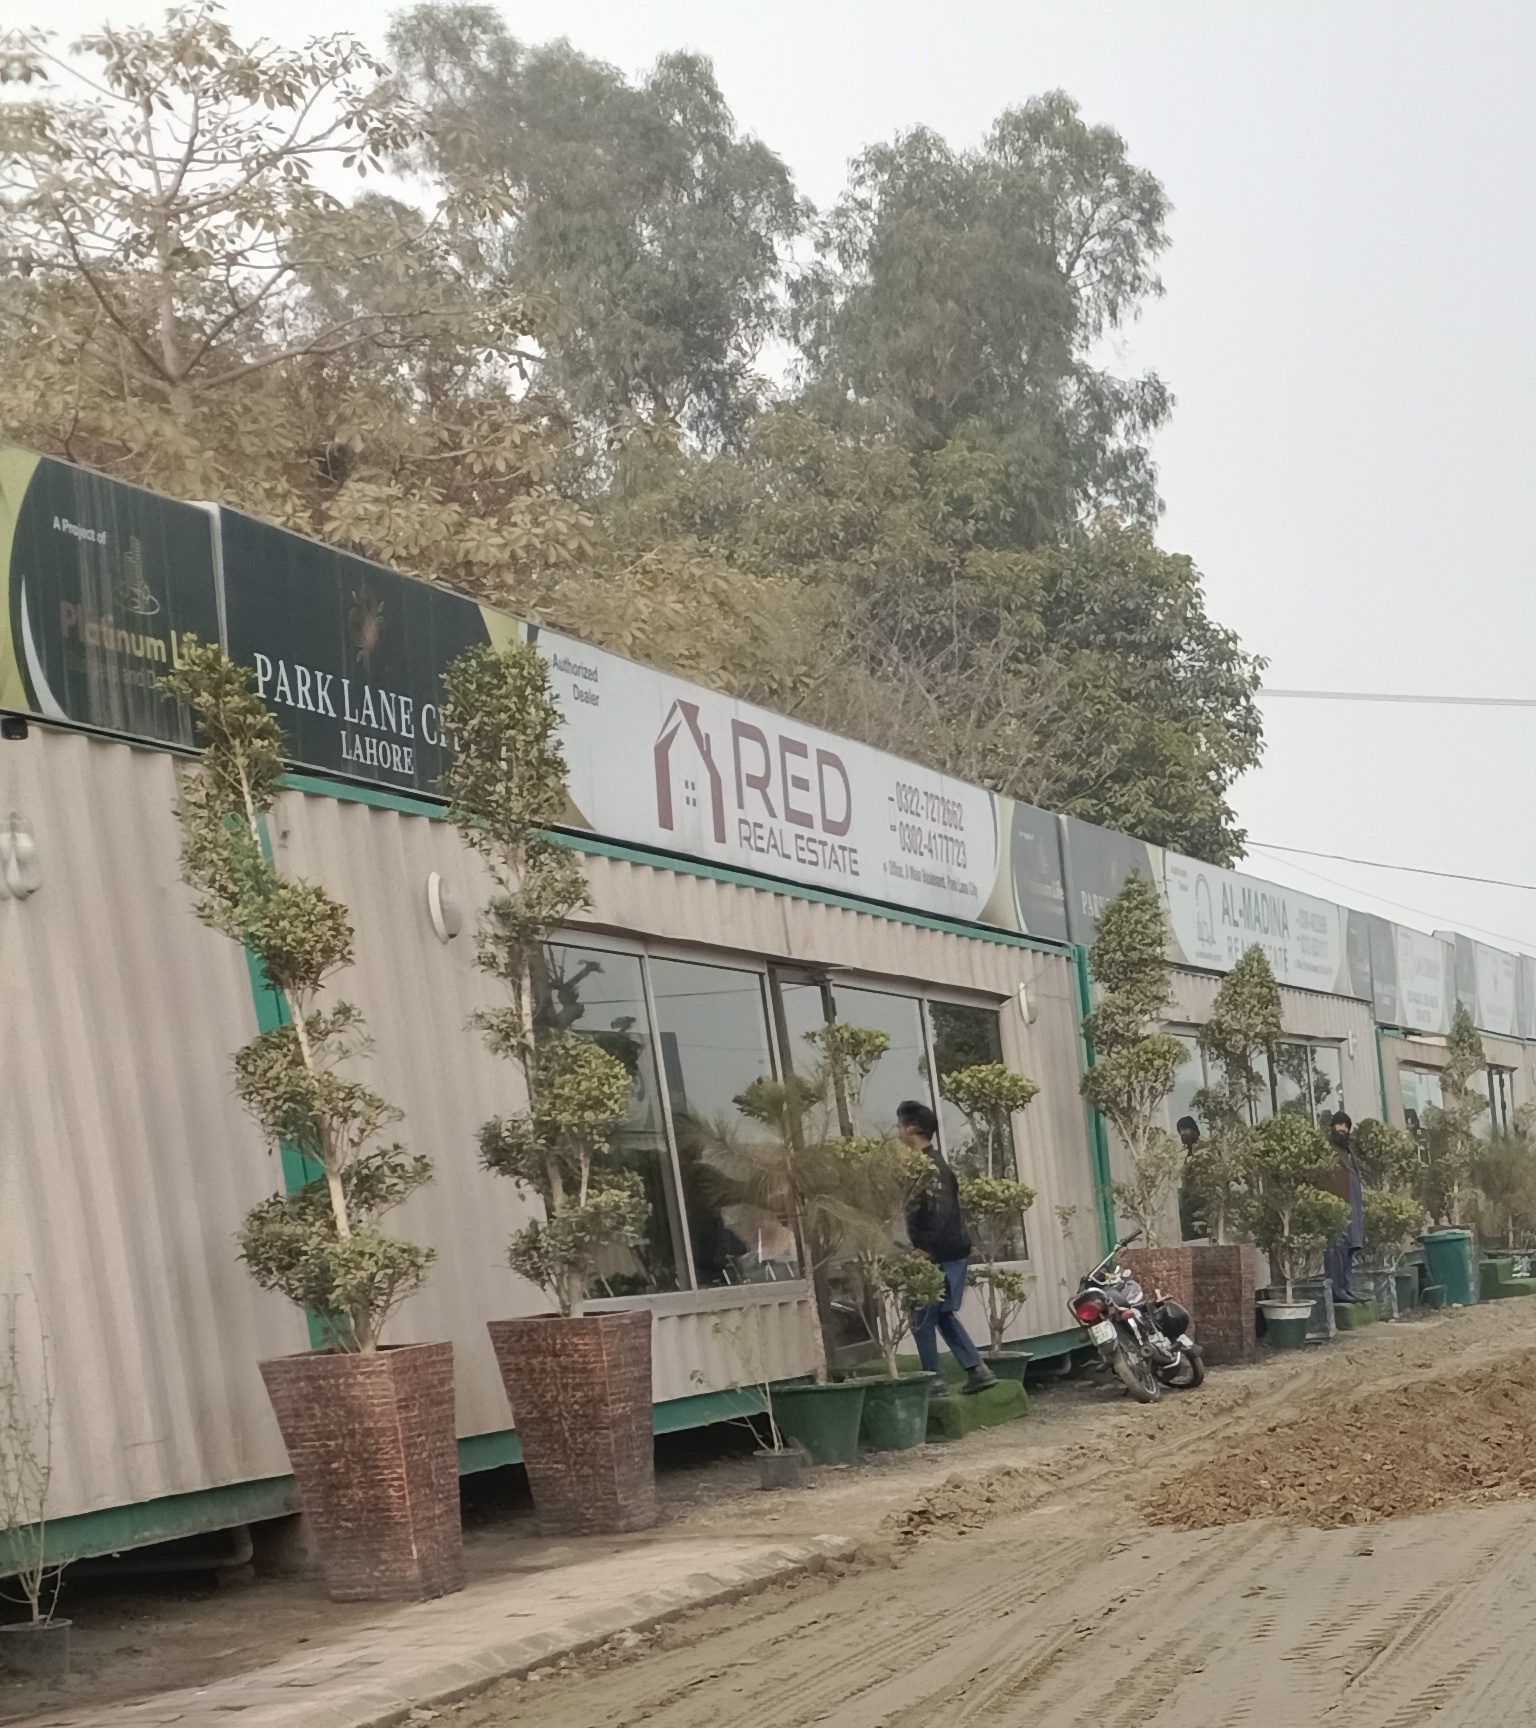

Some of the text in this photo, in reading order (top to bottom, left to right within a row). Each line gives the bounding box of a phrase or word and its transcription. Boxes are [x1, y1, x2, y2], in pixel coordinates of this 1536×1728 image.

[553, 653, 598, 683] Authorized
[254, 652, 337, 718] PARK
[341, 678, 415, 739] LANE
[573, 683, 600, 706] Dealer
[340, 730, 415, 775] LAHORE
[731, 719, 852, 837] RED
[738, 818, 792, 860] REAL
[795, 833, 860, 876] ESTATE
[1080, 890, 1107, 919] PAR
[1221, 881, 1290, 940] AL-MADINA
